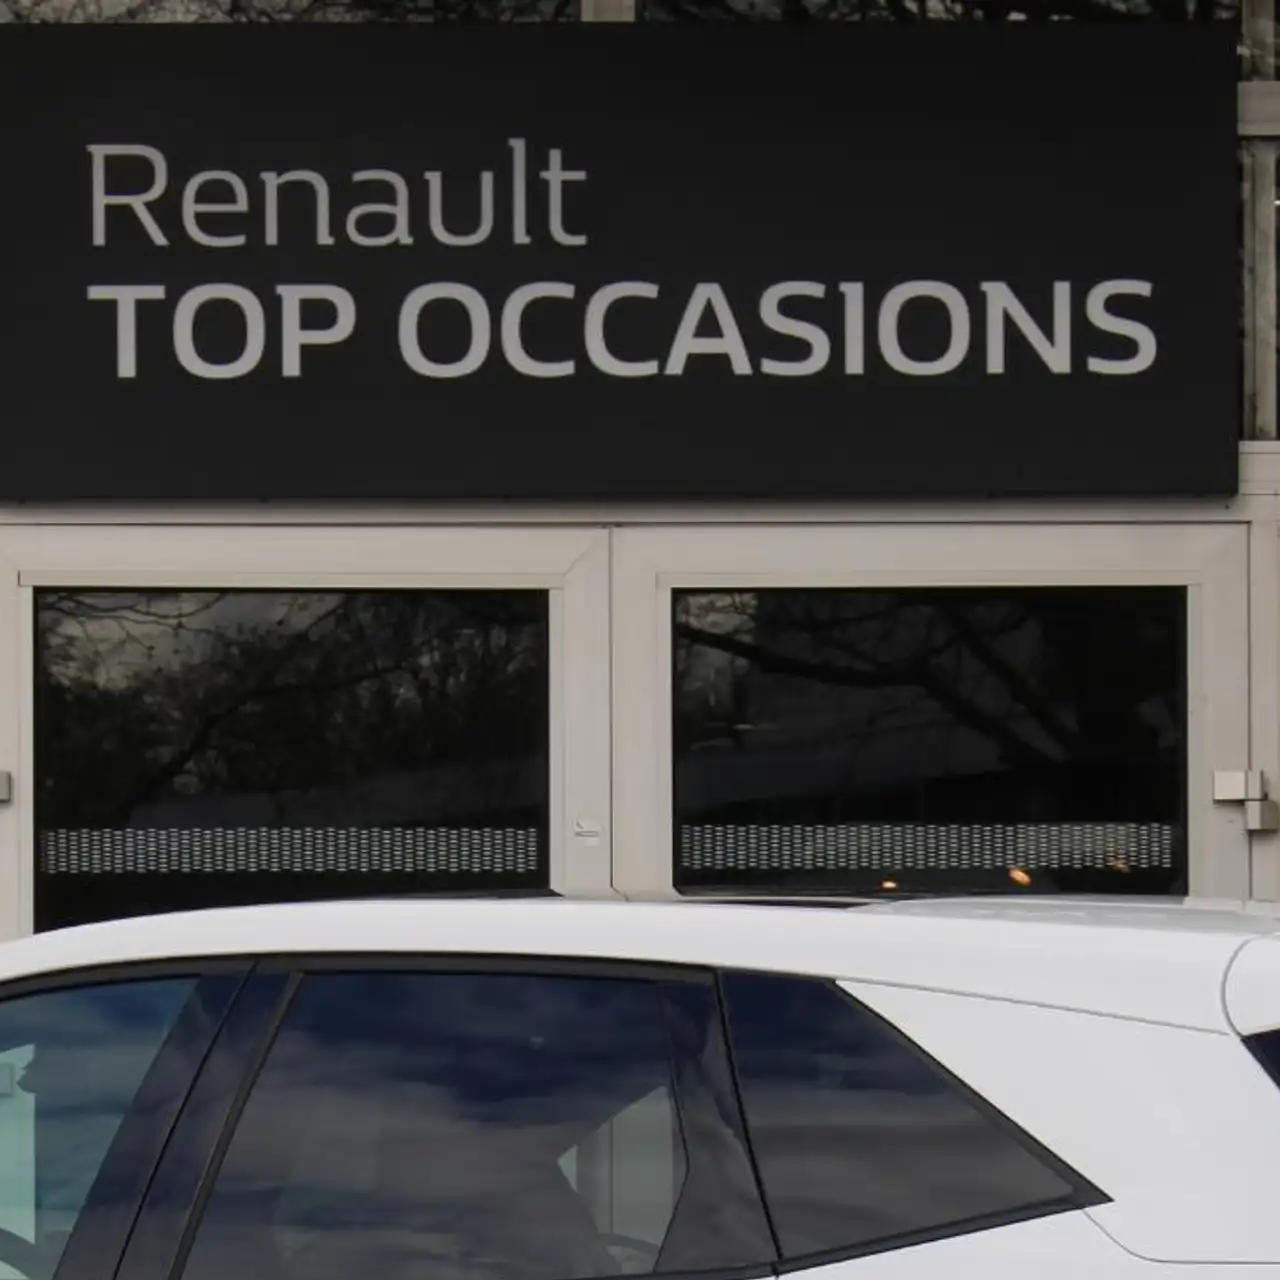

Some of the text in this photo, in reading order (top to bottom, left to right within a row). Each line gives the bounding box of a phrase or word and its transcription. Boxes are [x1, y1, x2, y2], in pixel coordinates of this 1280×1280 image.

[86, 137, 588, 247] Renault
[86, 280, 1158, 379] TOP OCCASIONS
